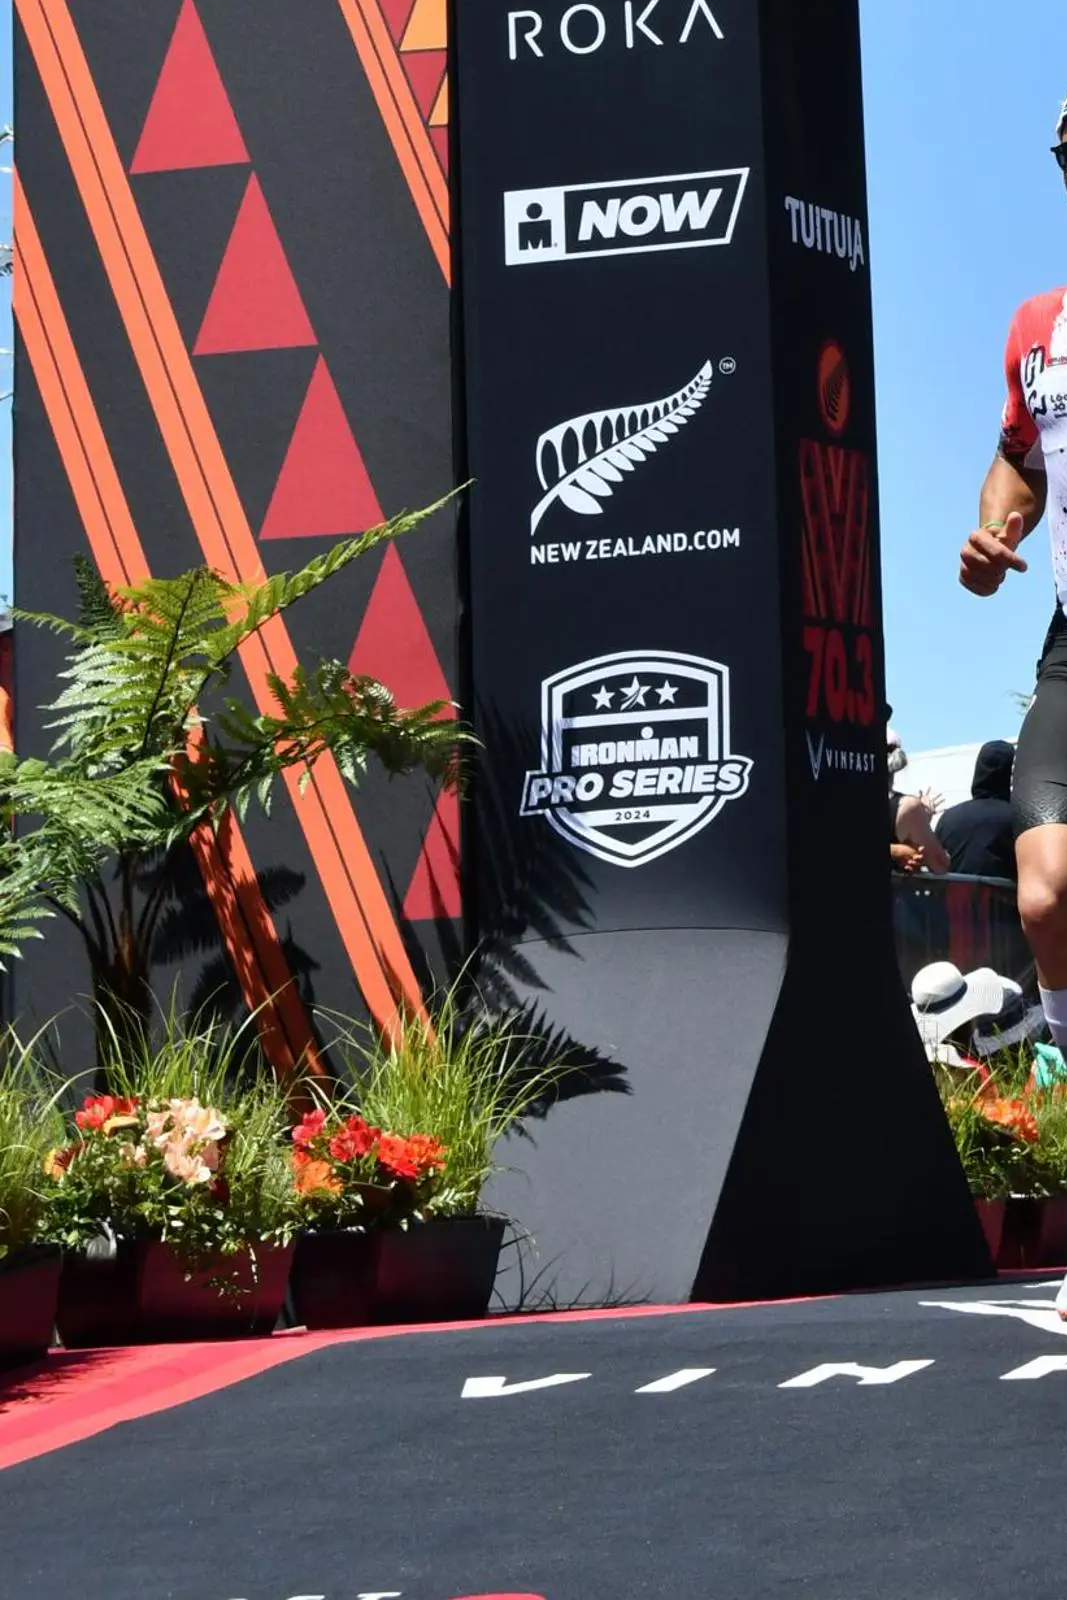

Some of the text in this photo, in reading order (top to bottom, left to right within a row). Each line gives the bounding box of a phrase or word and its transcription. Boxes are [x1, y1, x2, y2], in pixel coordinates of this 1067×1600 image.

[577, 187, 723, 242] NOW
[571, 735, 699, 768] IRONMAN
[825, 748, 876, 772] VINFAST
[528, 762, 744, 807] PRO SERIES
[614, 809, 651, 822] 2024
